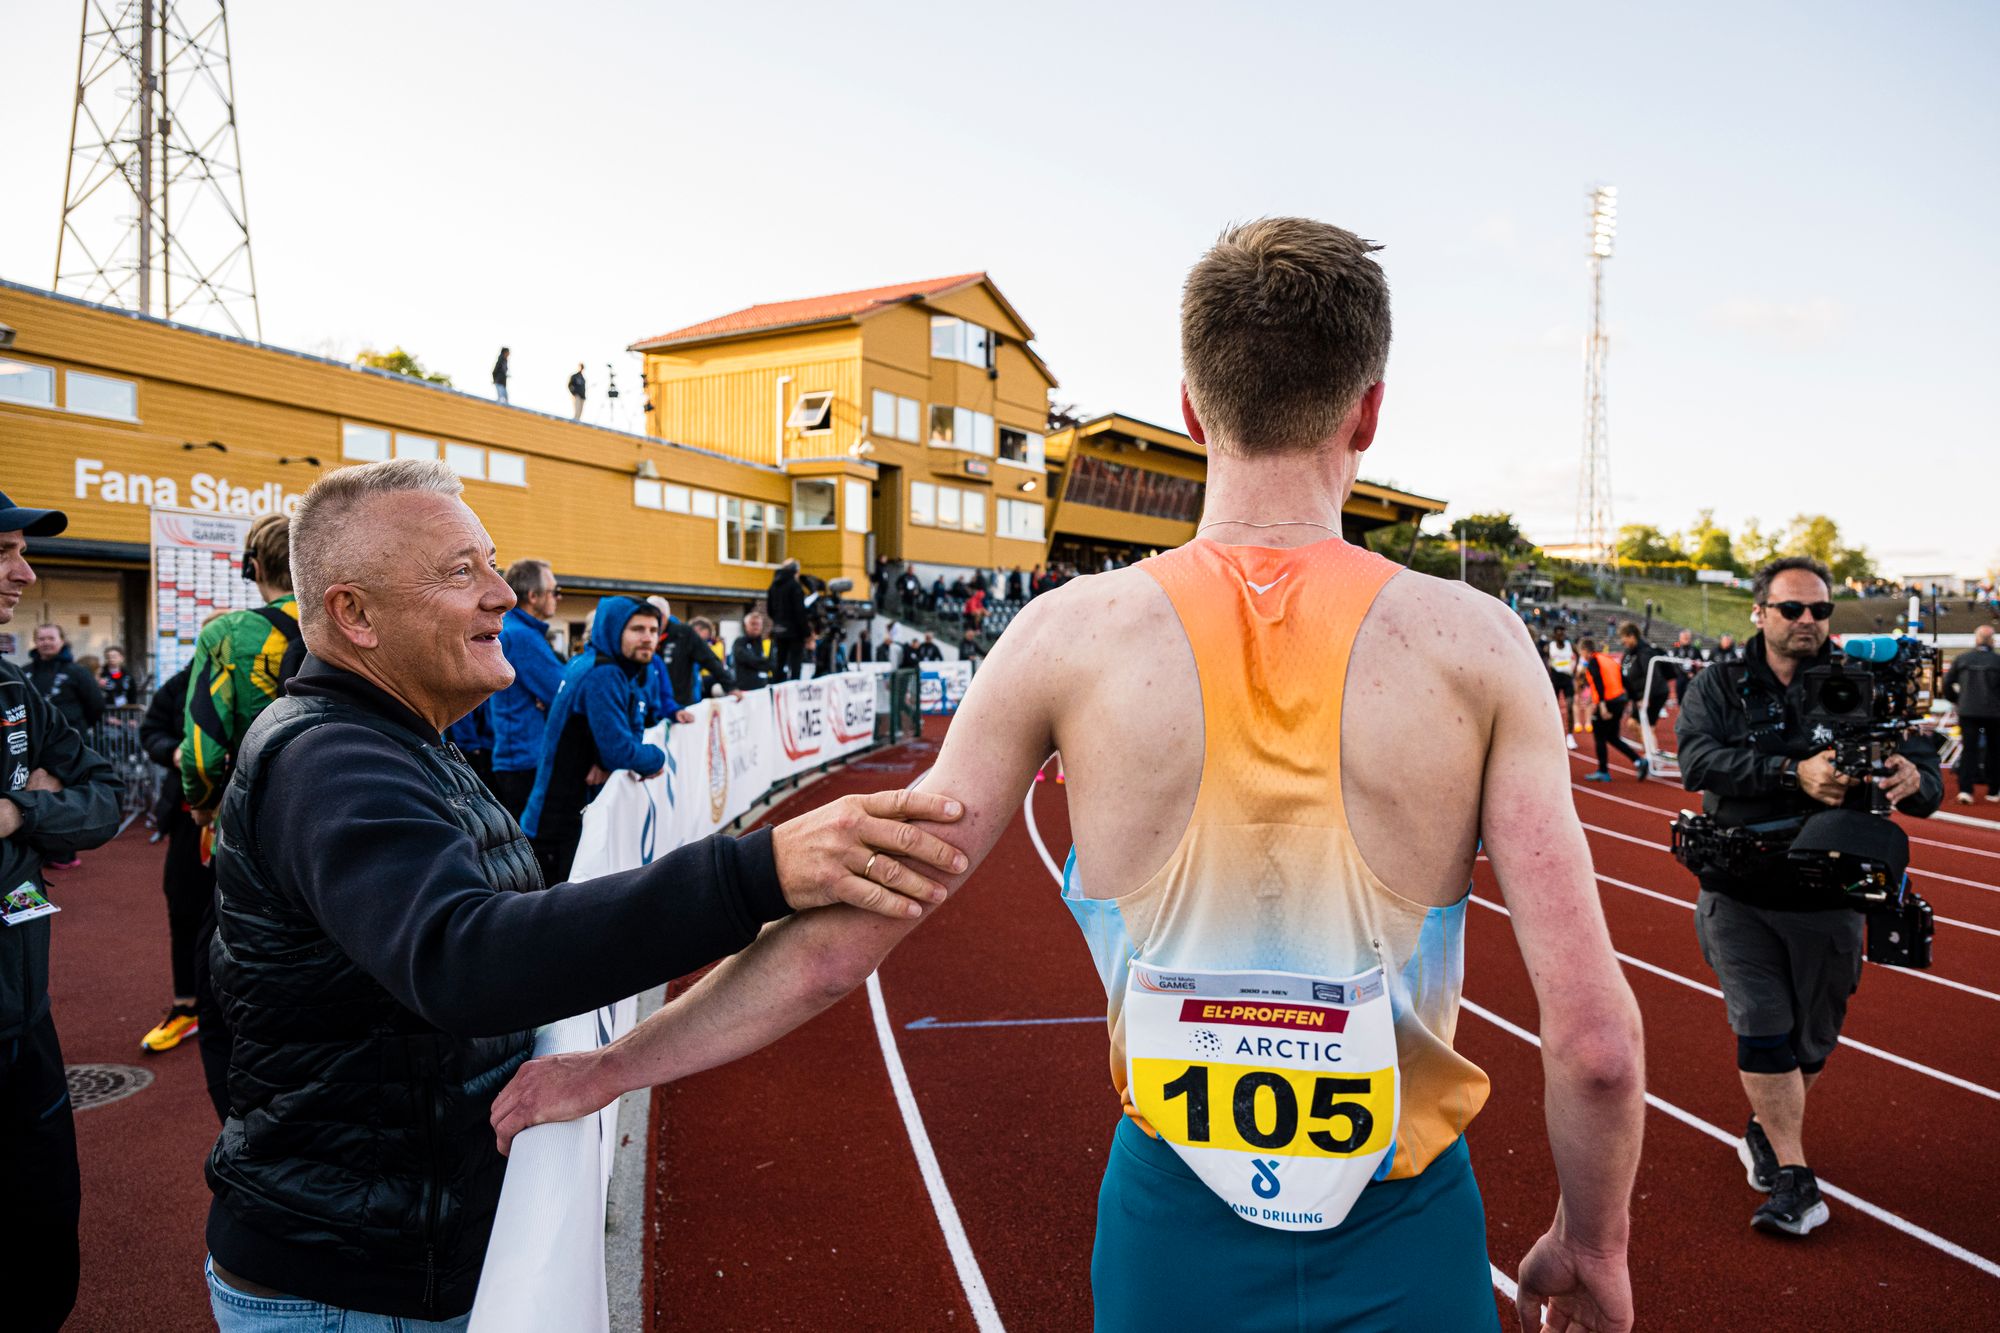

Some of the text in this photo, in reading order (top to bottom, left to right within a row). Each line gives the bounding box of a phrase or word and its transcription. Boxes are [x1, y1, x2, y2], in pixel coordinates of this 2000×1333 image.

[75, 458, 178, 506] Fana
[1159, 981, 1196, 990] GAMES
[1202, 1005, 1325, 1026] EL-PROFFEN
[1236, 1036, 1342, 1062] ARCTIC
[1163, 1065, 1374, 1154] 105
[1263, 1209, 1323, 1223] DRILLING
